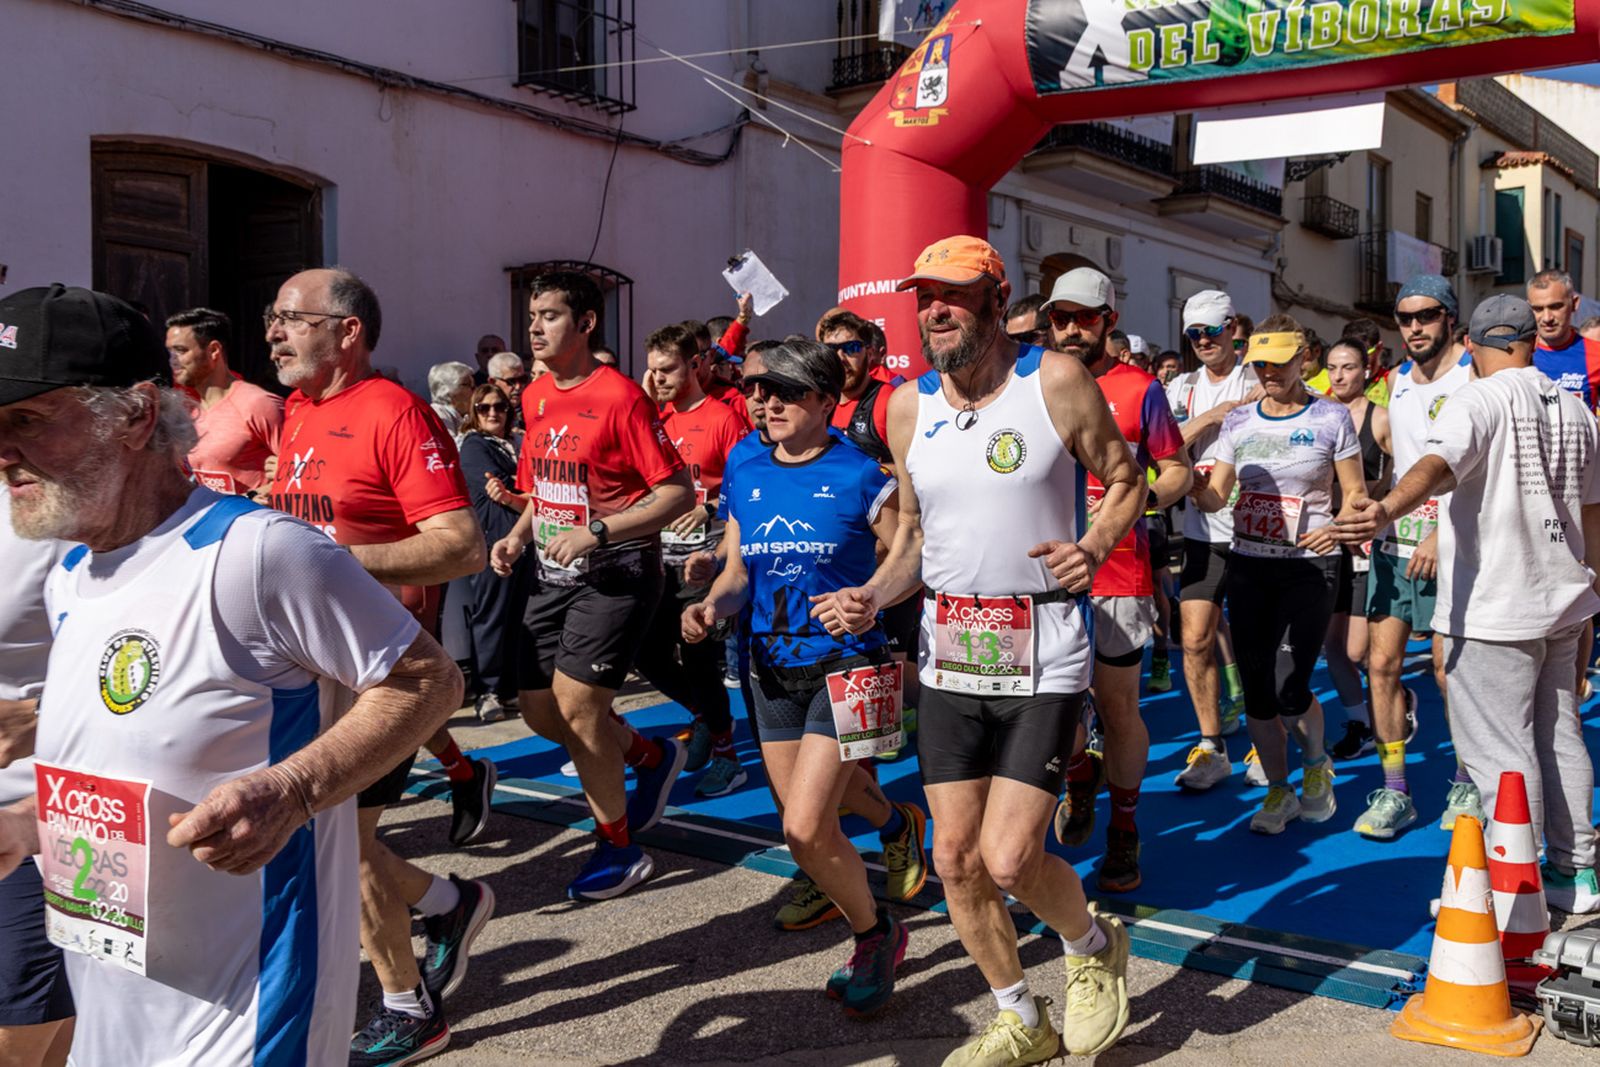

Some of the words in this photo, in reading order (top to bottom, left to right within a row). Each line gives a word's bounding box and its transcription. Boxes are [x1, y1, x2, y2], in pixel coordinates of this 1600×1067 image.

[1126, 19, 1220, 72] DEL
[903, 117, 929, 125] MARTOS
[535, 433, 581, 452] CROSS
[276, 459, 327, 482] CROSS
[543, 507, 576, 521] CROSS
[1243, 512, 1285, 538] 142
[946, 599, 960, 618] X
[960, 606, 1014, 622] CROSS
[946, 617, 1001, 633] PANTANO
[960, 629, 1001, 665] 13
[999, 651, 1015, 662] 20
[942, 661, 963, 671] DIEGO
[842, 674, 860, 693] X
[860, 673, 895, 690] CROSS
[845, 686, 890, 704] PANTANO
[840, 731, 861, 741] MARY
[45, 774, 66, 809] X
[65, 789, 126, 824] CROSS
[46, 809, 109, 845] PANTANO
[110, 829, 127, 841] DEL
[70, 836, 97, 900] 2
[109, 880, 129, 903] 20
